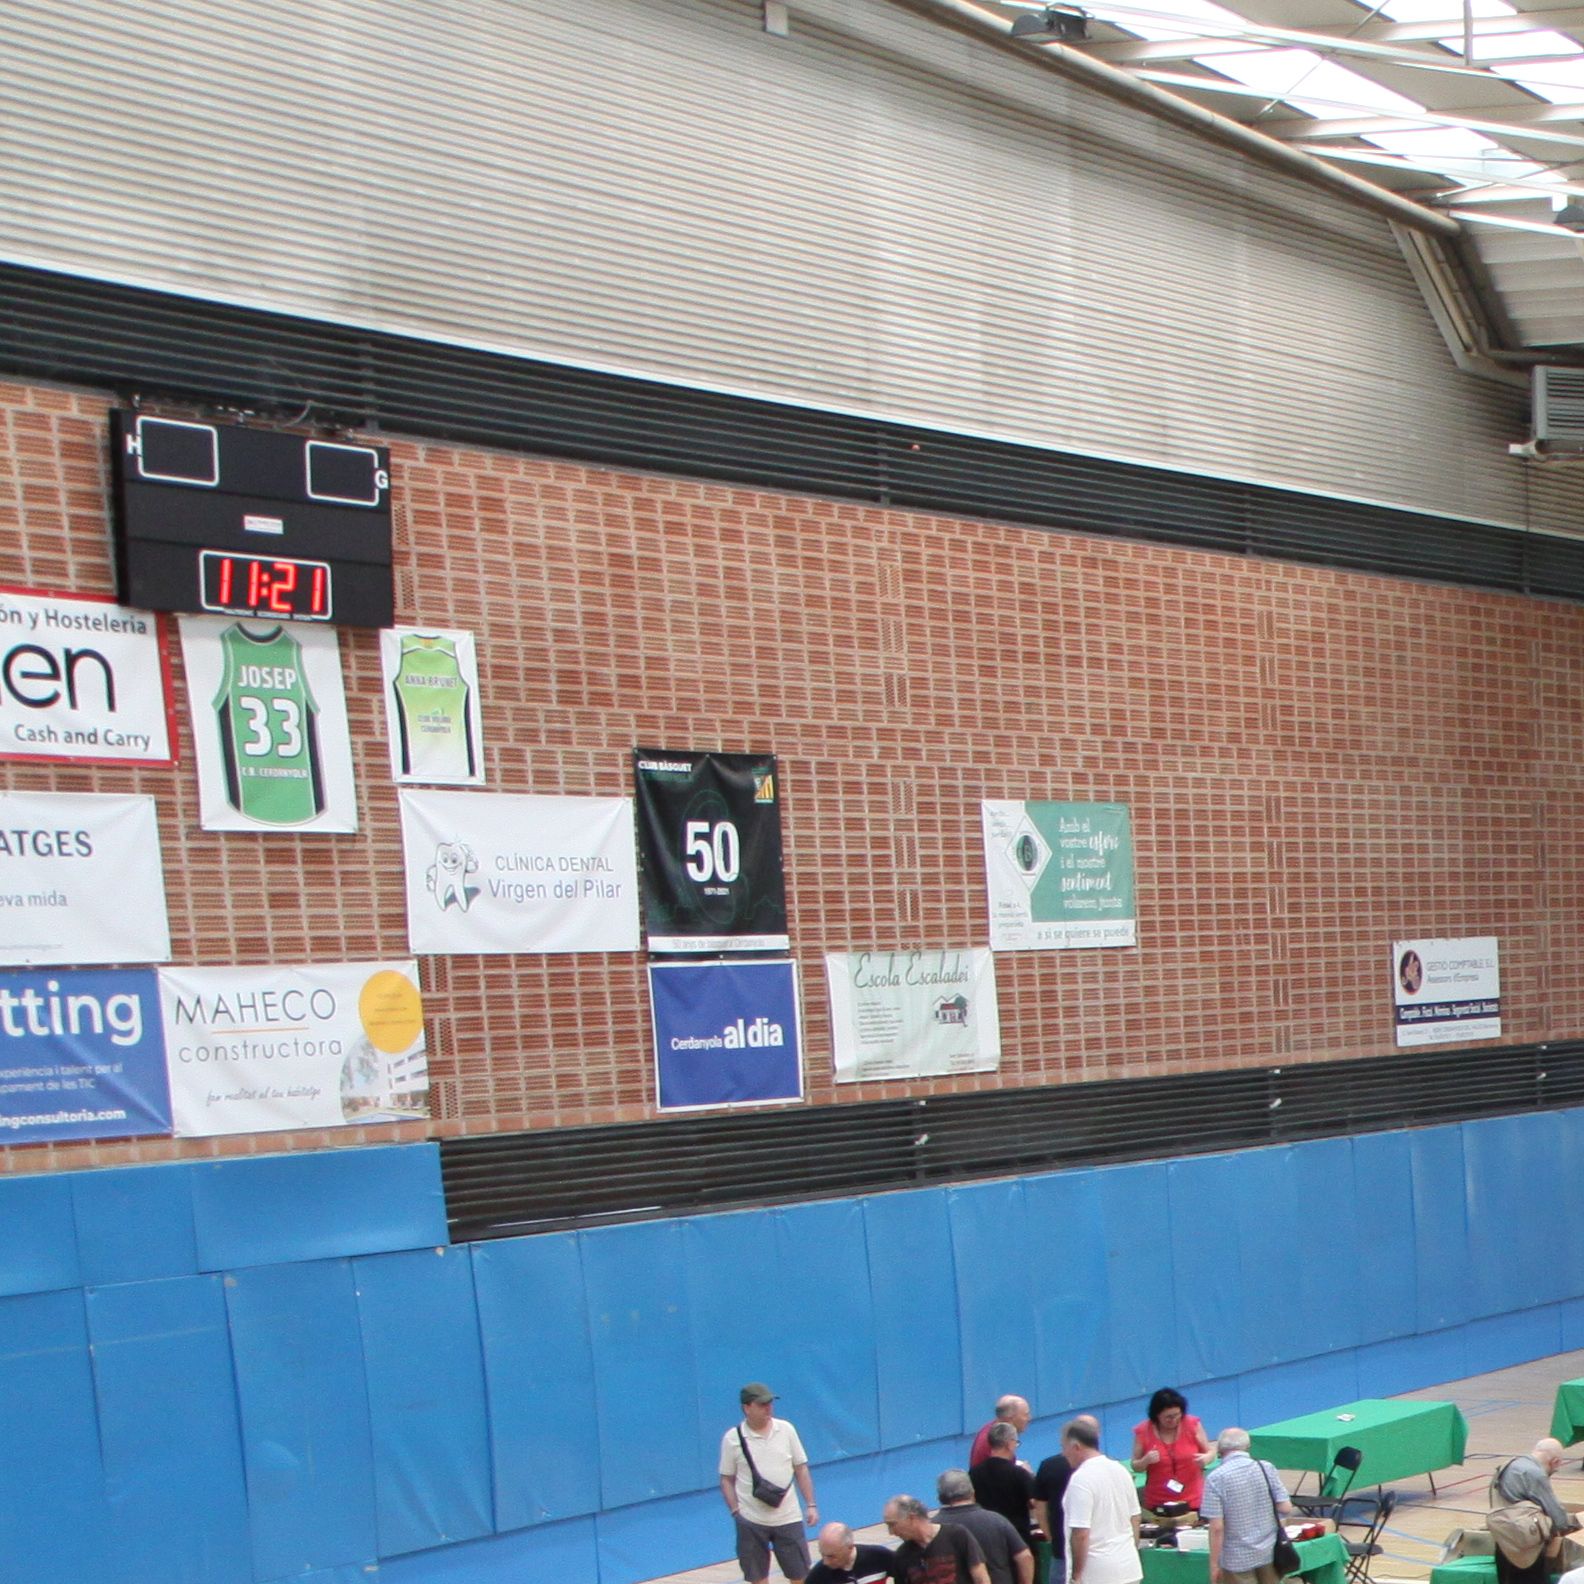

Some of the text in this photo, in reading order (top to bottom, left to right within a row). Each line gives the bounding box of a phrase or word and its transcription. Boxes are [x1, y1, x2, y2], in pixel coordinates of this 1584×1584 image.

[126, 434, 141, 454] H
[374, 470, 389, 489] G
[219, 558, 324, 612] 11:21
[28, 611, 39, 630] y
[44, 608, 148, 635] Hosteleria
[0, 642, 117, 712] en
[237, 664, 297, 690] JOSEP
[14, 723, 151, 751] Cash and Carry
[239, 696, 303, 758] 33
[495, 852, 614, 873] CLÍNICA DENTAL
[686, 820, 740, 883] 50
[28, 889, 68, 907] mida
[487, 878, 622, 903] Virgen del Pilar
[854, 950, 969, 988] Escola Escaladei
[175, 988, 336, 1025] MAHECO
[671, 1017, 784, 1051] Cerdanyola al dia
[179, 1037, 343, 1063] constructora
